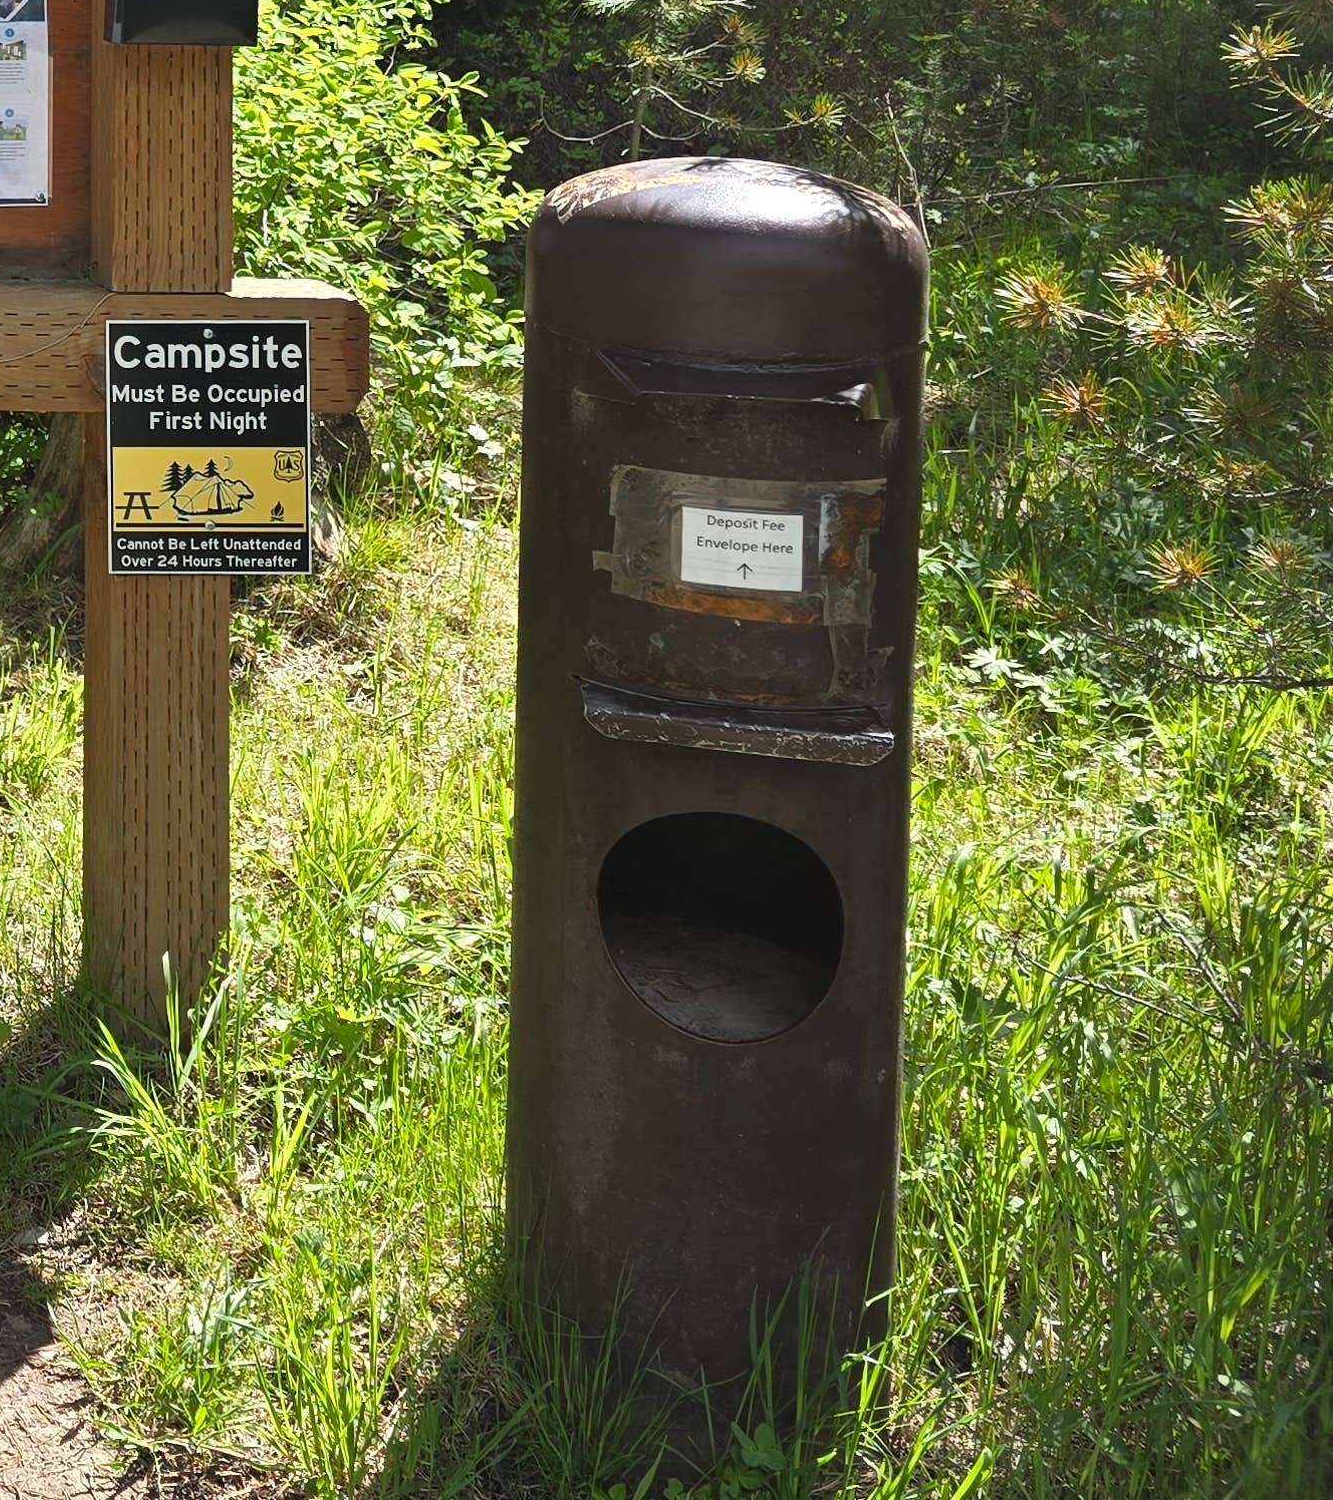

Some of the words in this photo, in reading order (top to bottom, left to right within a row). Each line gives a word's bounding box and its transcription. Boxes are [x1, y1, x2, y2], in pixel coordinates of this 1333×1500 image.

[114, 335, 302, 373] Campsite
[112, 385, 164, 403] Must
[172, 385, 200, 402] Be
[208, 384, 304, 407] Occupied
[149, 411, 202, 430] First
[209, 411, 267, 435] Night
[707, 515, 758, 530] Deposit
[763, 519, 785, 531] Fee
[117, 538, 164, 551] Cannot
[168, 539, 187, 550] Be
[191, 538, 218, 550] Left
[223, 539, 301, 551] Unattended
[696, 536, 759, 552] Envelope
[763, 542, 793, 554] Here
[121, 555, 153, 567] Over
[158, 555, 178, 567] 24
[183, 556, 222, 567] Hours
[226, 556, 297, 567] Thereafter
